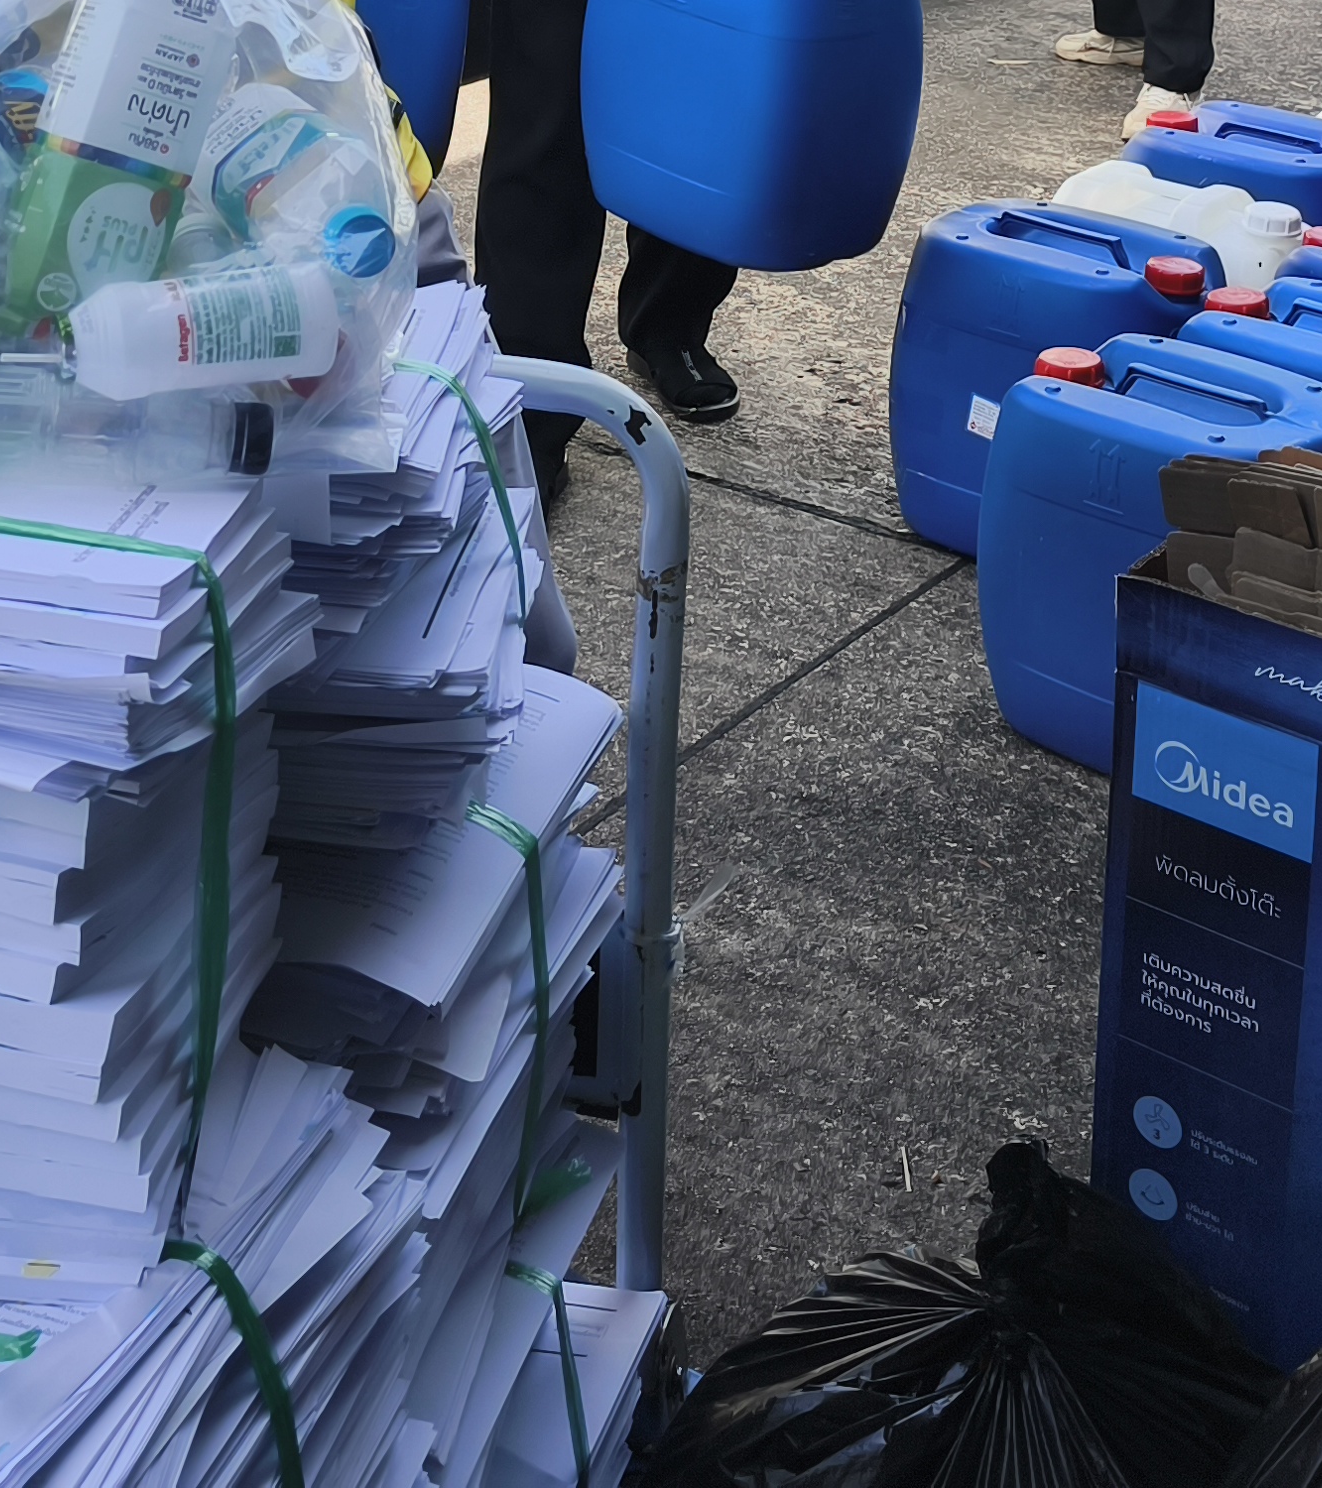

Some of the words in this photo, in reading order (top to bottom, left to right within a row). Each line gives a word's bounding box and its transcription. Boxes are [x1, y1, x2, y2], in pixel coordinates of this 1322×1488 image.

[155, 49, 184, 63] JAPAN
[102, 215, 138, 236] PLUS
[178, 314, 190, 362] Betagen
[1154, 740, 1294, 828] Midea
[1155, 853, 1282, 919] พัดลมตั้งโต๊ะ
[1141, 969, 1260, 1033] ให้คุณในทุกเวลา
[1143, 952, 1256, 1010] เติมความสดชื่น
[1140, 988, 1213, 1034] ที่ต้องการ
[1153, 1128, 1161, 1140] 3
